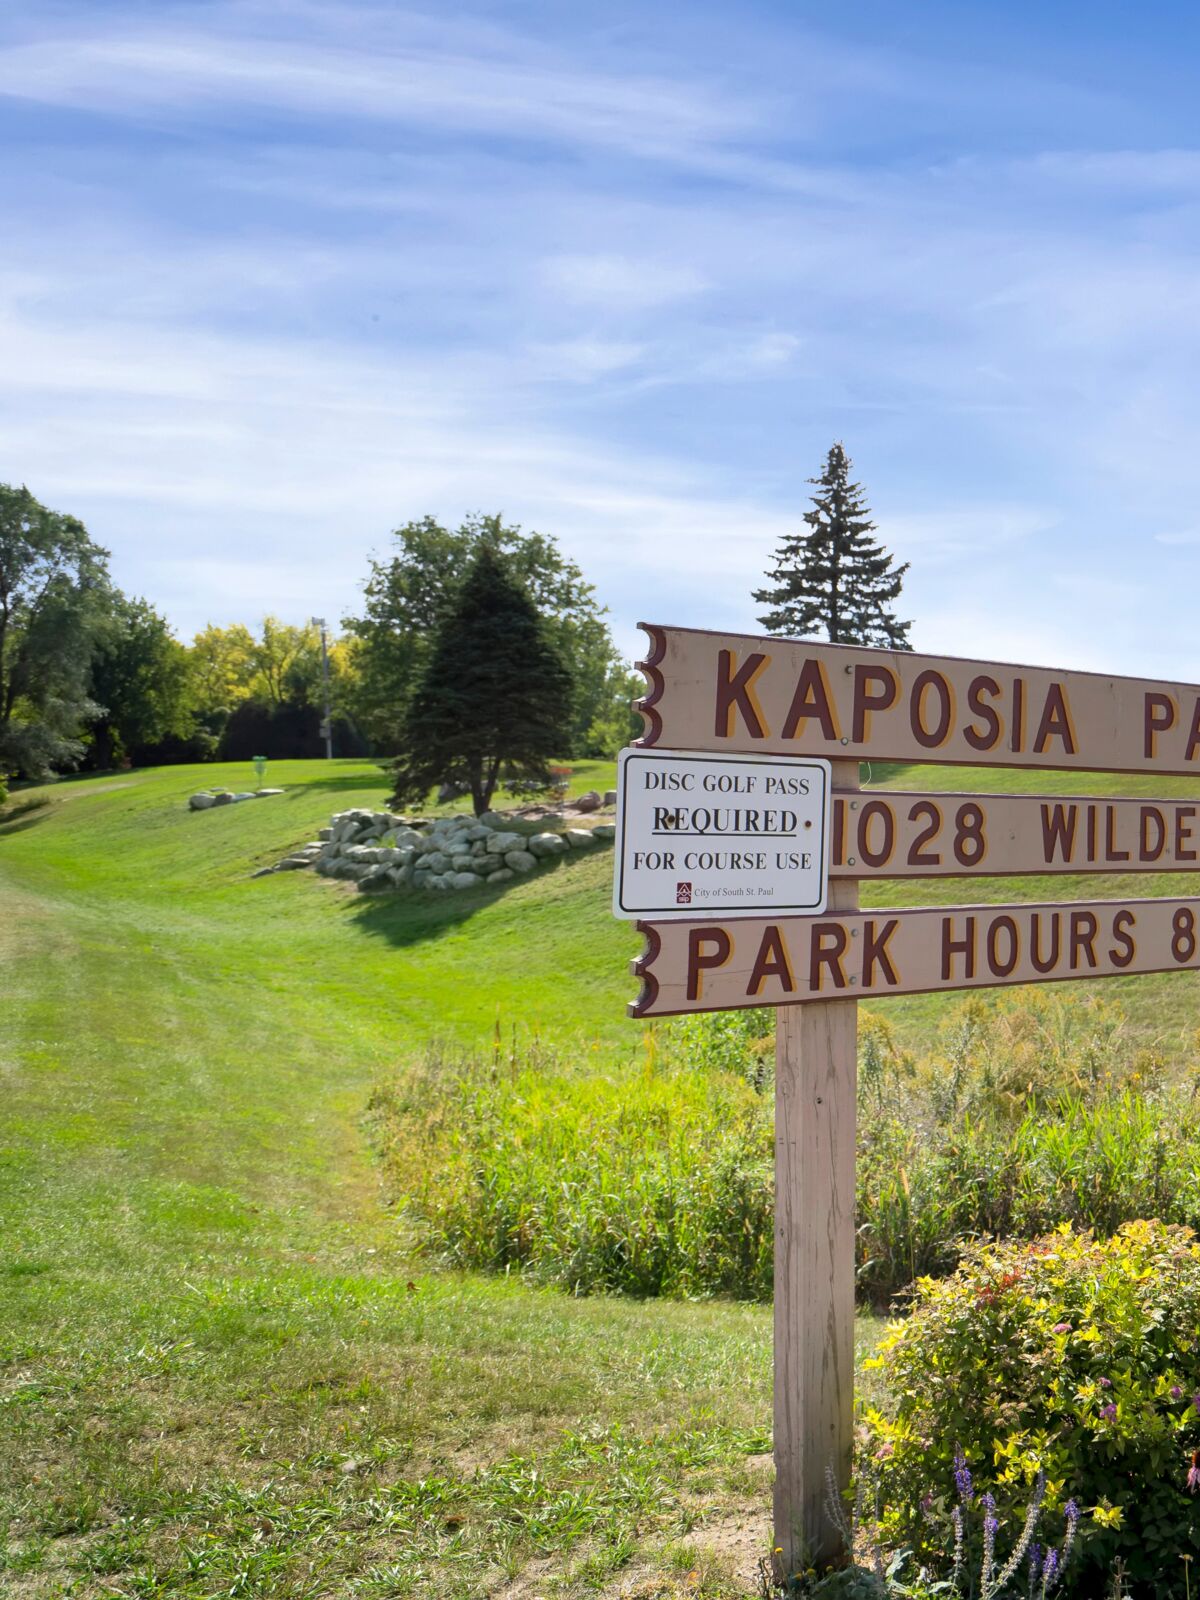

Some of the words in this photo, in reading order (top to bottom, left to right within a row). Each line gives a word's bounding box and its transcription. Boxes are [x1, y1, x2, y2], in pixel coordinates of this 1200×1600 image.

[714, 649, 1080, 754] KAPOSIA
[644, 772, 695, 791] DISC
[703, 775, 757, 793] GOLF
[765, 777, 810, 795] PASS
[652, 807, 798, 834] REQUIRED
[833, 799, 988, 867] 1028
[1040, 804, 1198, 863] WILDE
[633, 852, 676, 870] FOR
[684, 852, 767, 870] COURSE
[776, 853, 812, 870] USE
[694, 888, 710, 898] City
[712, 888, 721, 896] of
[722, 888, 744, 896] South
[758, 888, 774, 896] Paul
[686, 919, 901, 1001] PARK
[941, 909, 1136, 981] HOURS
